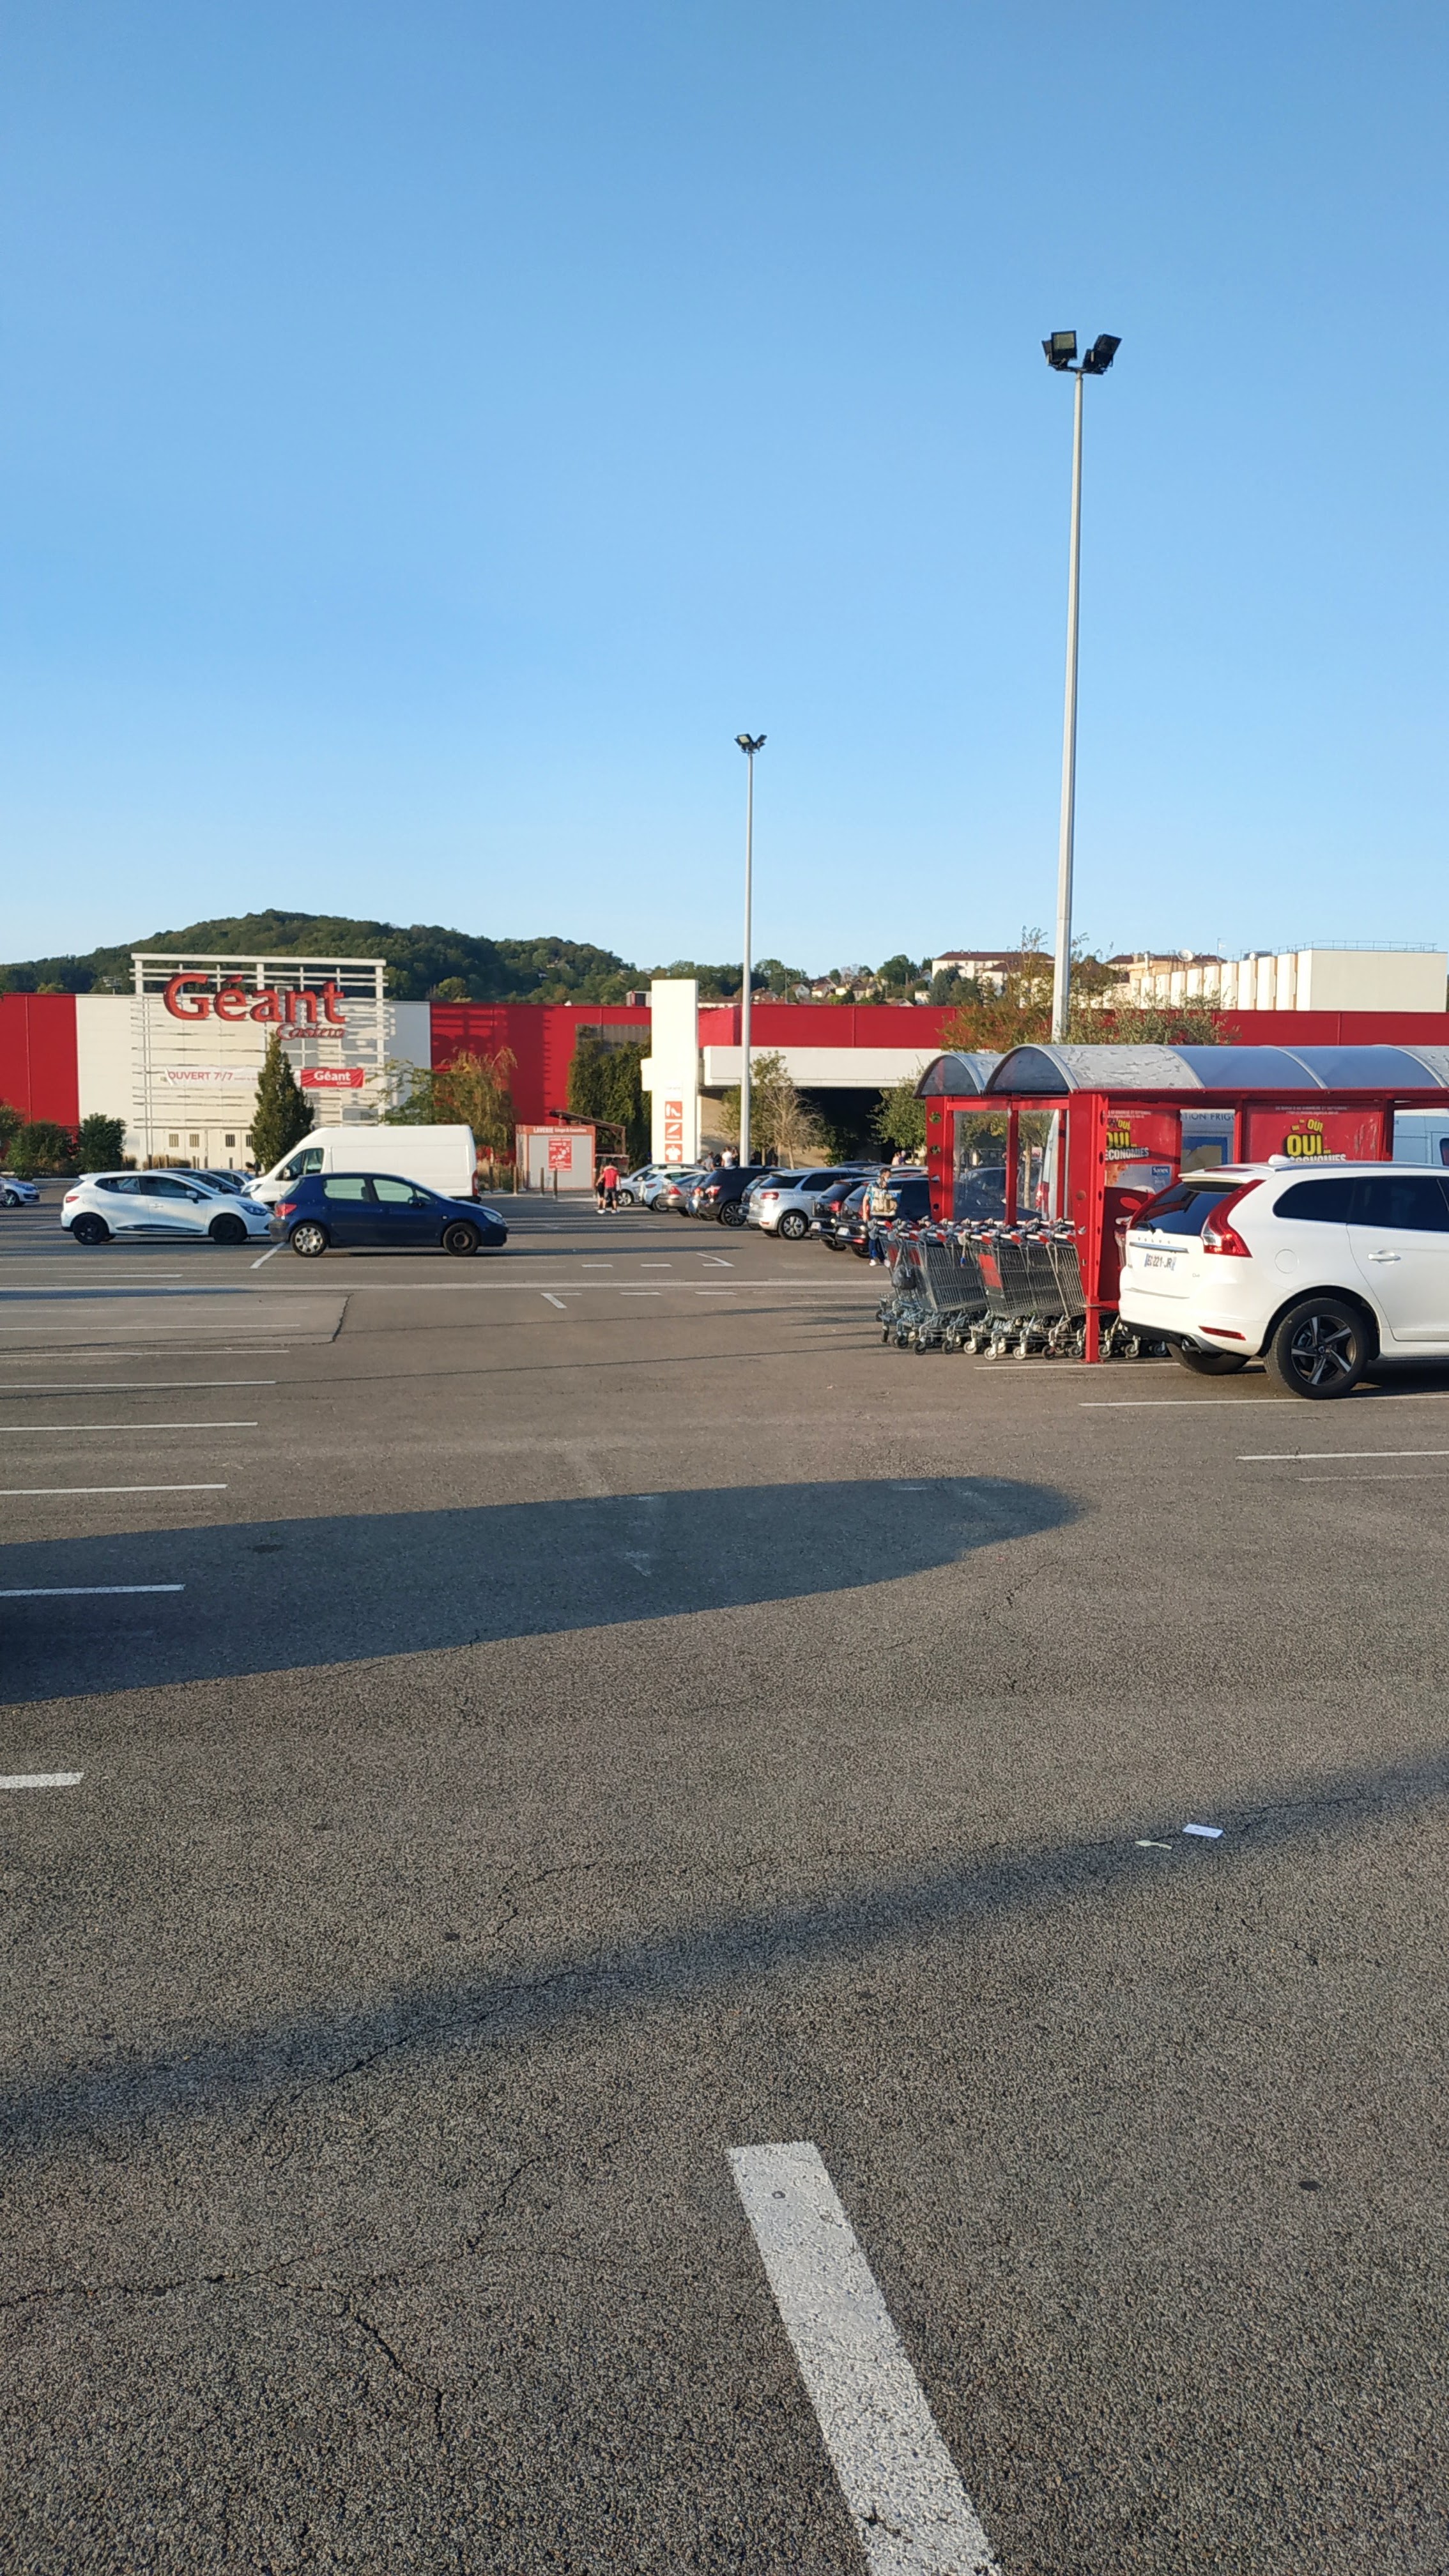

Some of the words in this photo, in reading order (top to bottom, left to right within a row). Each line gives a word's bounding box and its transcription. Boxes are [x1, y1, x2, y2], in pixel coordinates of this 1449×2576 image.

[164, 973, 346, 1023] Géant
[276, 1023, 346, 1041] Casino
[168, 1071, 211, 1080] OUVERT
[314, 1071, 351, 1081] Géant
[1307, 1119, 1323, 1132] OUI
[1287, 1134, 1322, 1156] OUI
